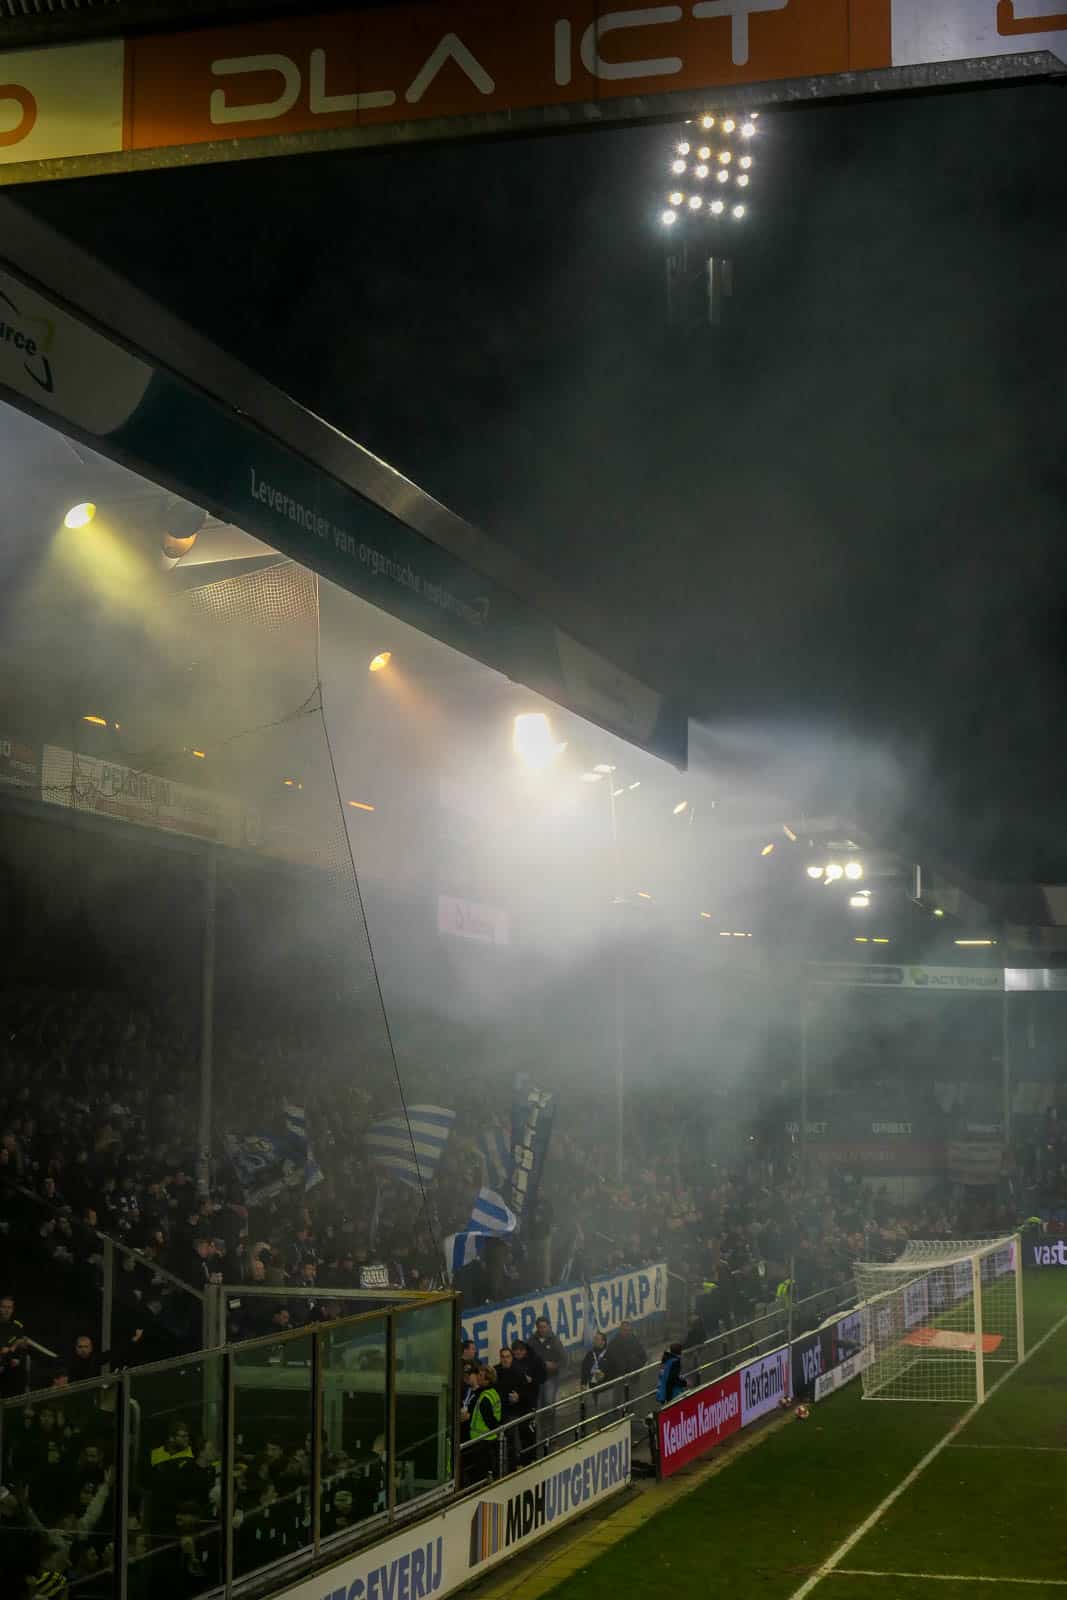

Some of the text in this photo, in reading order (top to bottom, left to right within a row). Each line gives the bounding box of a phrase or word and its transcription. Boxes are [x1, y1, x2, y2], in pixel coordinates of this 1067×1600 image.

[554, 0, 789, 86] ICT
[250, 468, 331, 538] Leverancier
[333, 526, 356, 558] van
[663, 1389, 739, 1457] Keuken Kampioen
[505, 1437, 629, 1547] MDHUITGEVERIJ
[320, 1535, 443, 1600] EVERIJ
